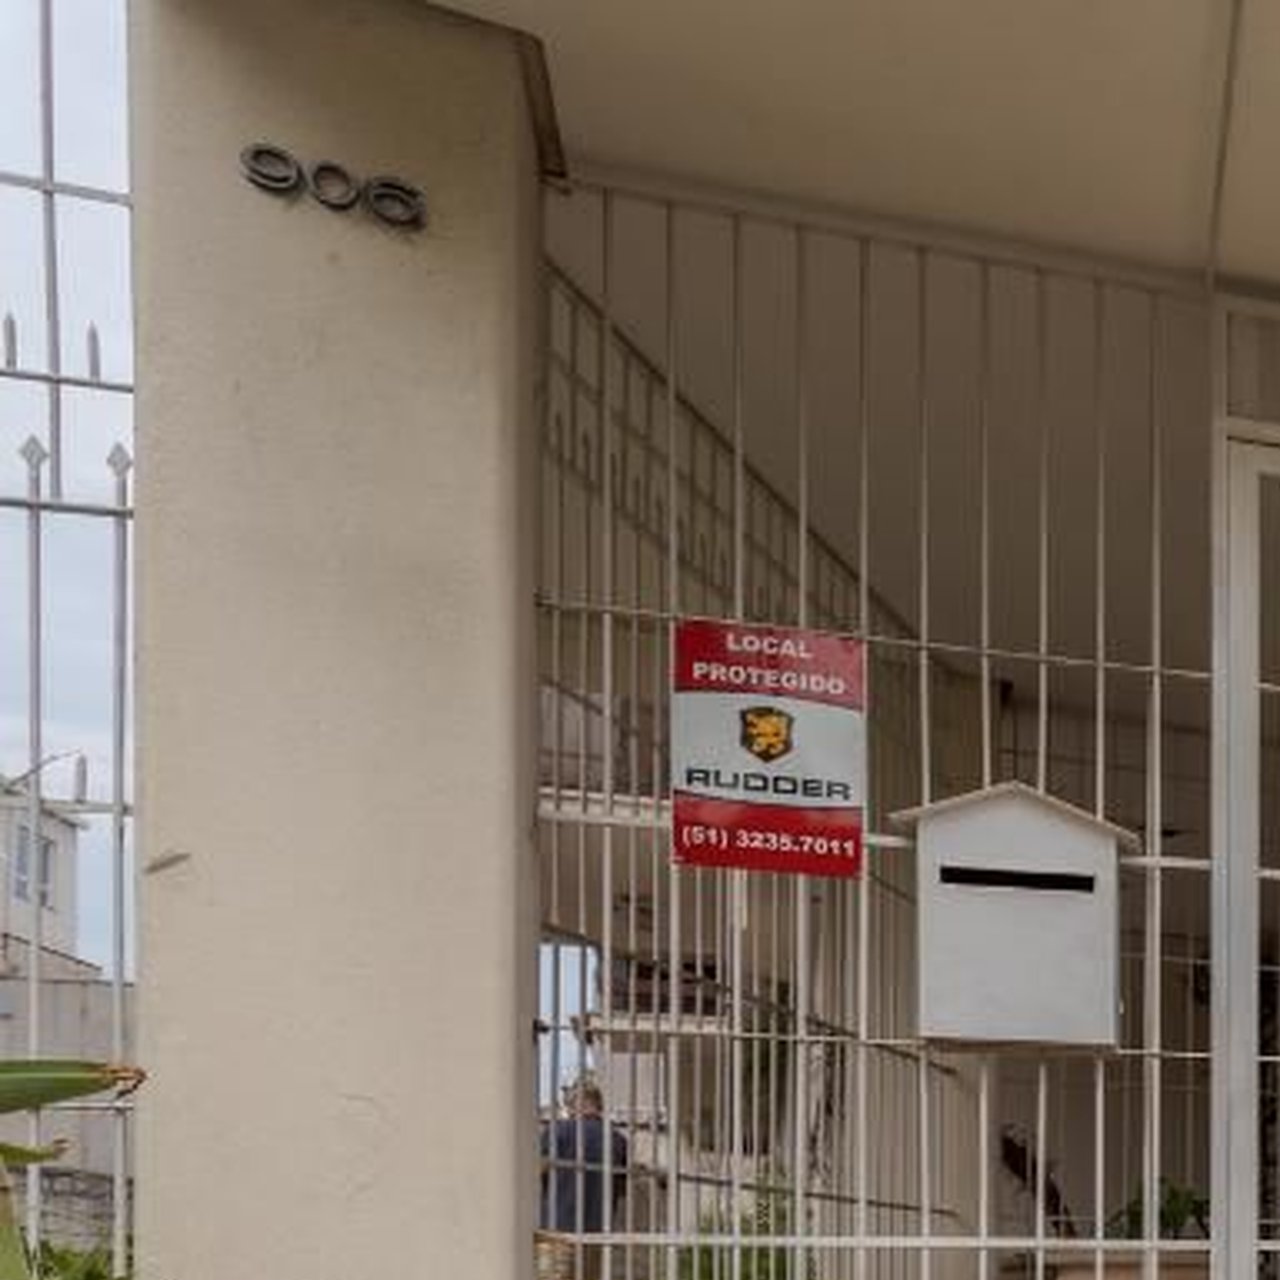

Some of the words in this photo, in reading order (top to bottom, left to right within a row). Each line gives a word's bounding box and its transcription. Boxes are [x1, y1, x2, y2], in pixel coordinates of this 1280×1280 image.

[240, 142, 427, 232] 906
[726, 633, 814, 659] LOCAL
[692, 661, 846, 694] PROTEGIDO
[686, 768, 852, 800] RUDDER
[682, 826, 728, 847] (51)
[736, 829, 855, 857] 3235.7011
